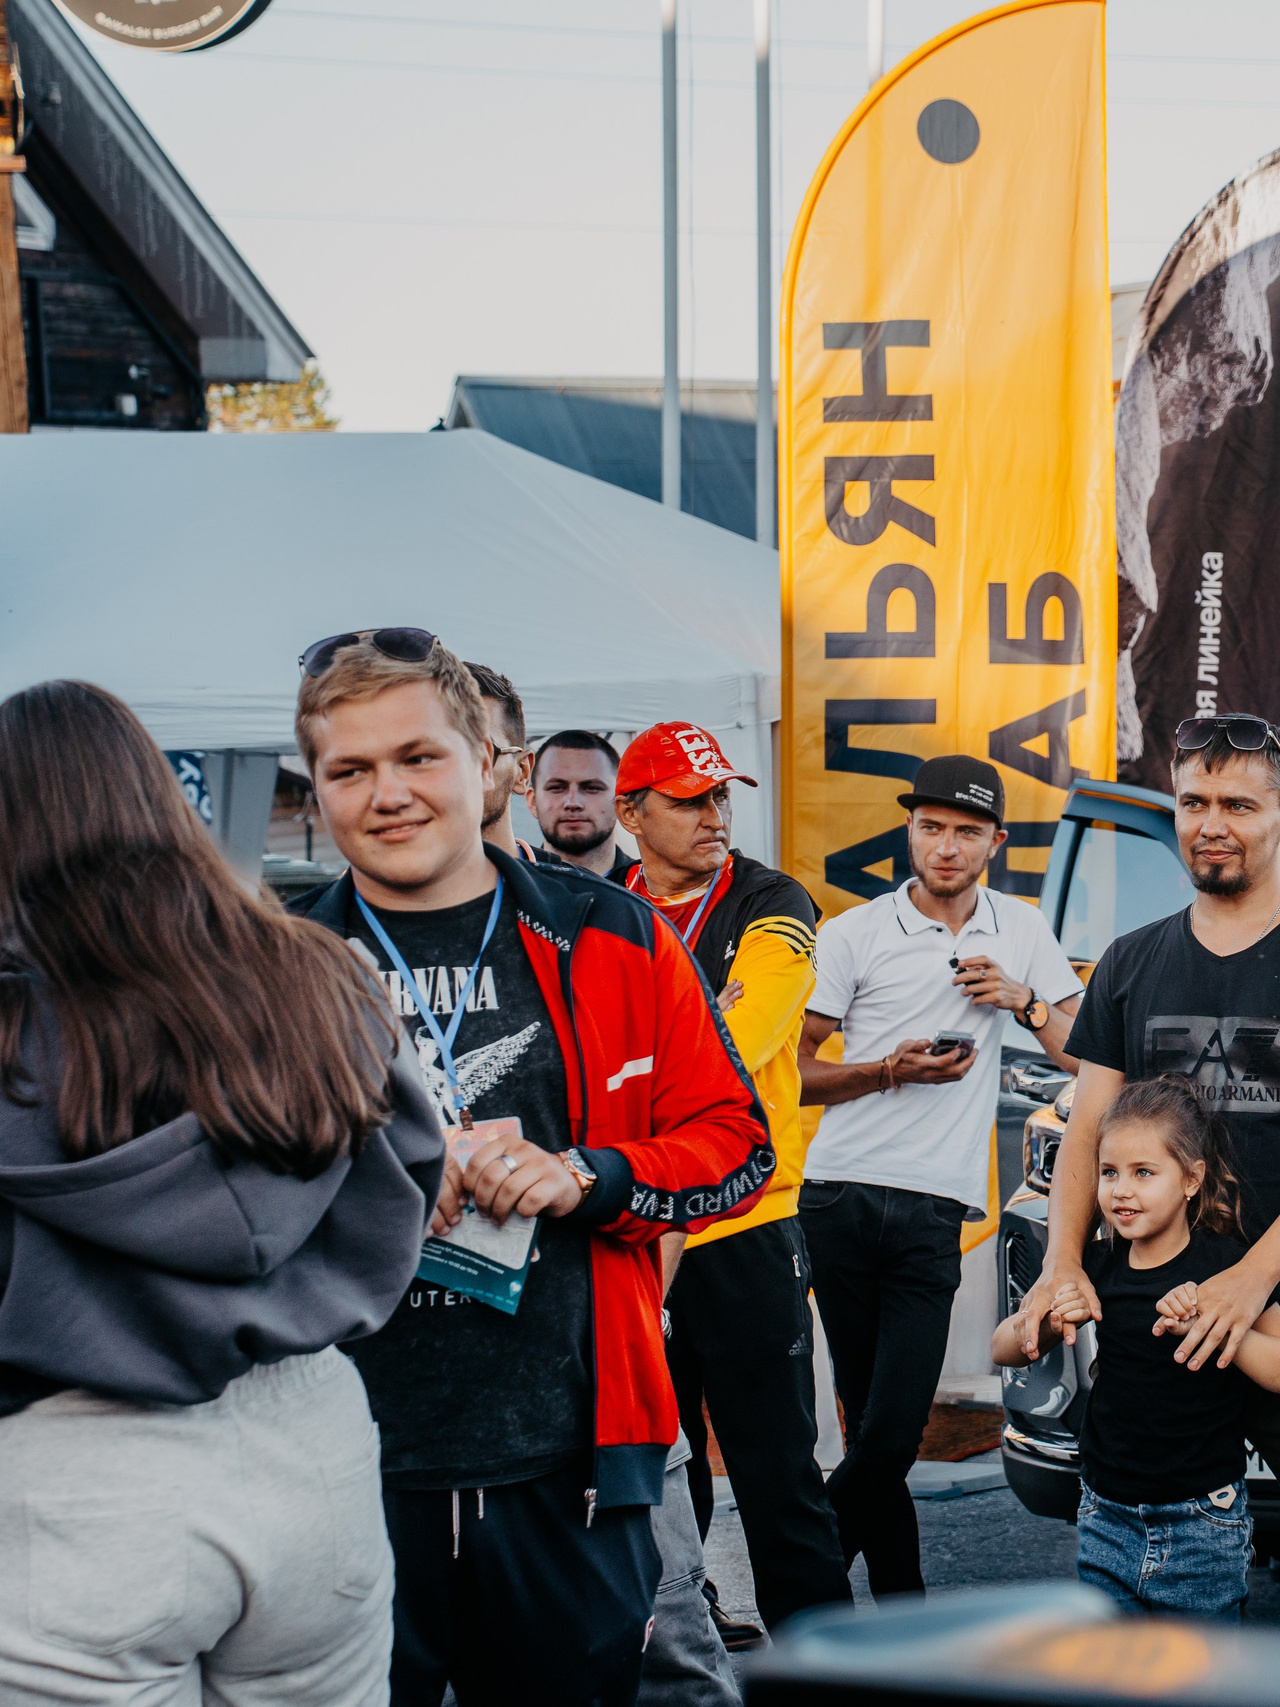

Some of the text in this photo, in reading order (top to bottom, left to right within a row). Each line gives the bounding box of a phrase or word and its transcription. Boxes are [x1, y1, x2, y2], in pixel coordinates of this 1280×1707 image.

[152, 19, 200, 40] BURGER
[199, 5, 223, 27] BAR
[1194, 551, 1224, 686] линейка
[379, 966, 500, 1016] RVANA
